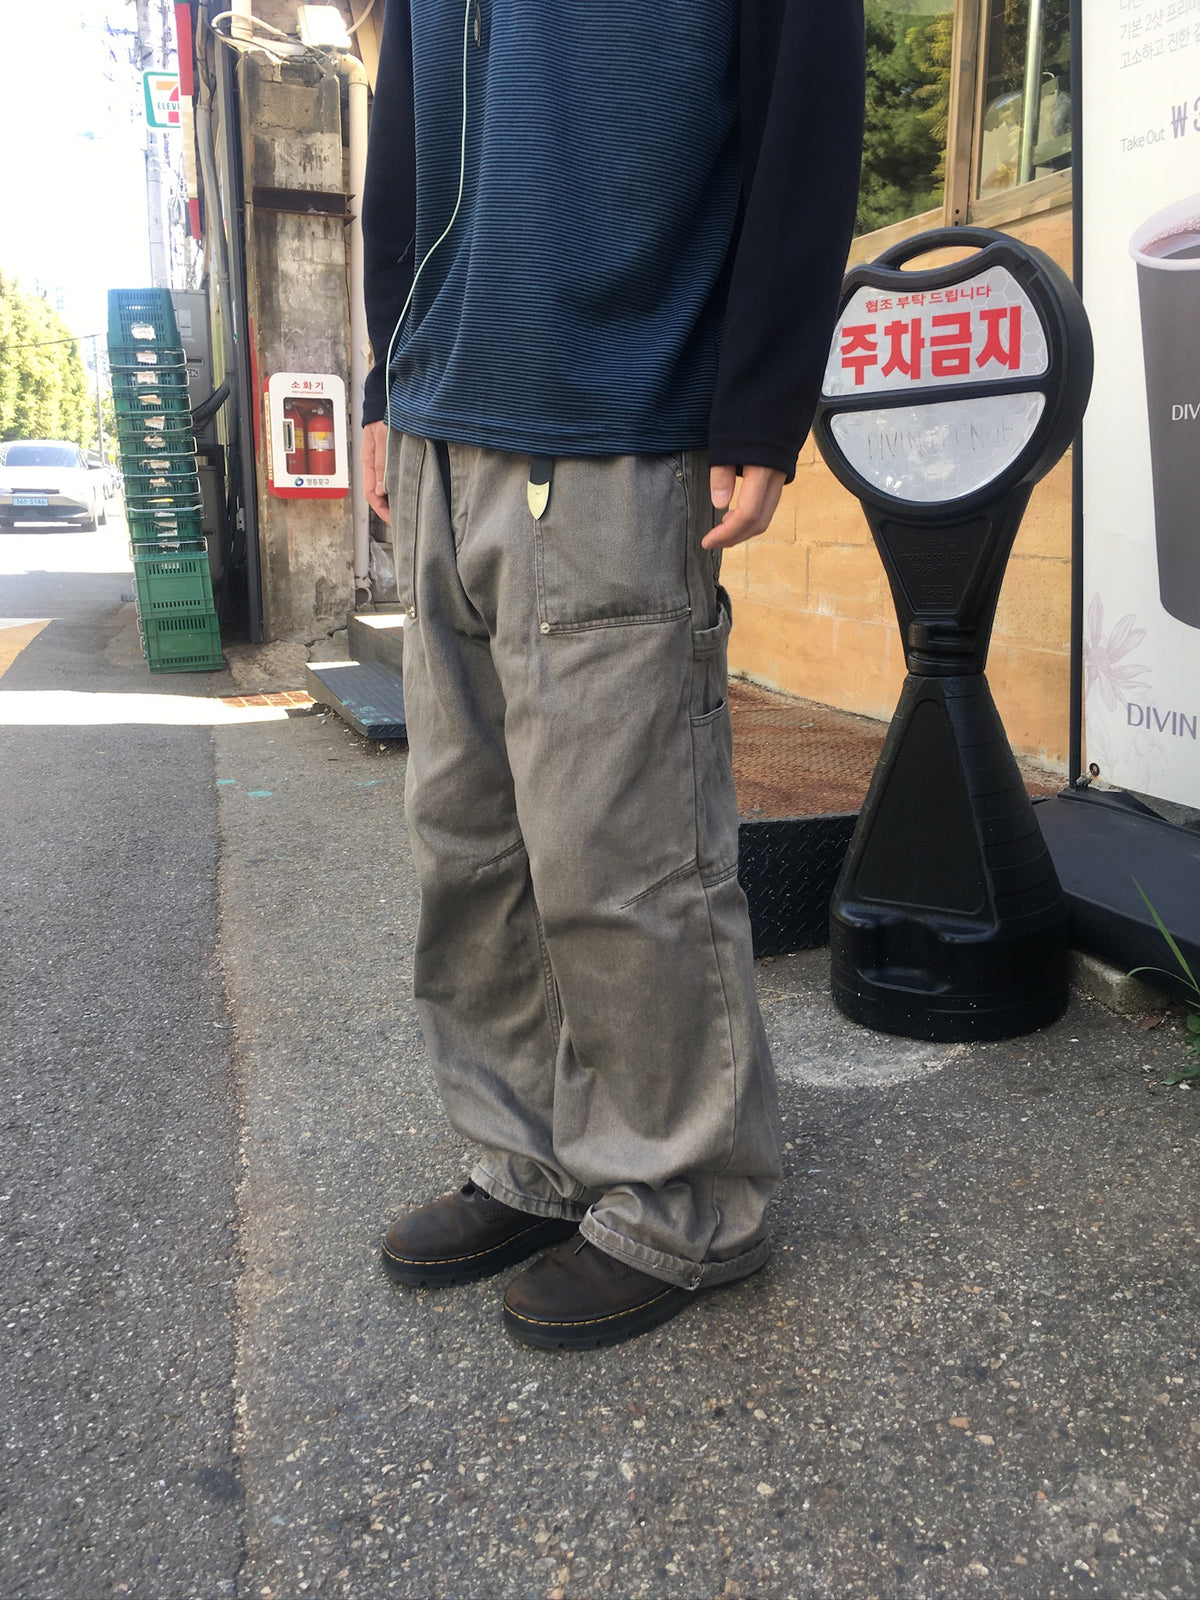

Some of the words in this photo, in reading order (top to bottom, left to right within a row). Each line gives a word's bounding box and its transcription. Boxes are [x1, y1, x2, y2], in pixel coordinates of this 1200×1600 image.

[1120, 18, 1142, 40] 기본
[1145, 8, 1163, 31] 2샷
[1120, 39, 1165, 69] 고소하고
[1167, 26, 1190, 53] 진한
[1120, 135, 1145, 153] Take
[1146, 128, 1165, 145] Out
[865, 298, 893, 313] 협조
[896, 293, 926, 309] 부탁
[929, 284, 992, 304] 드립니다
[840, 305, 1022, 386] 주차금지
[1172, 403, 1200, 421] DIV
[1127, 702, 1197, 740] DIVIN
